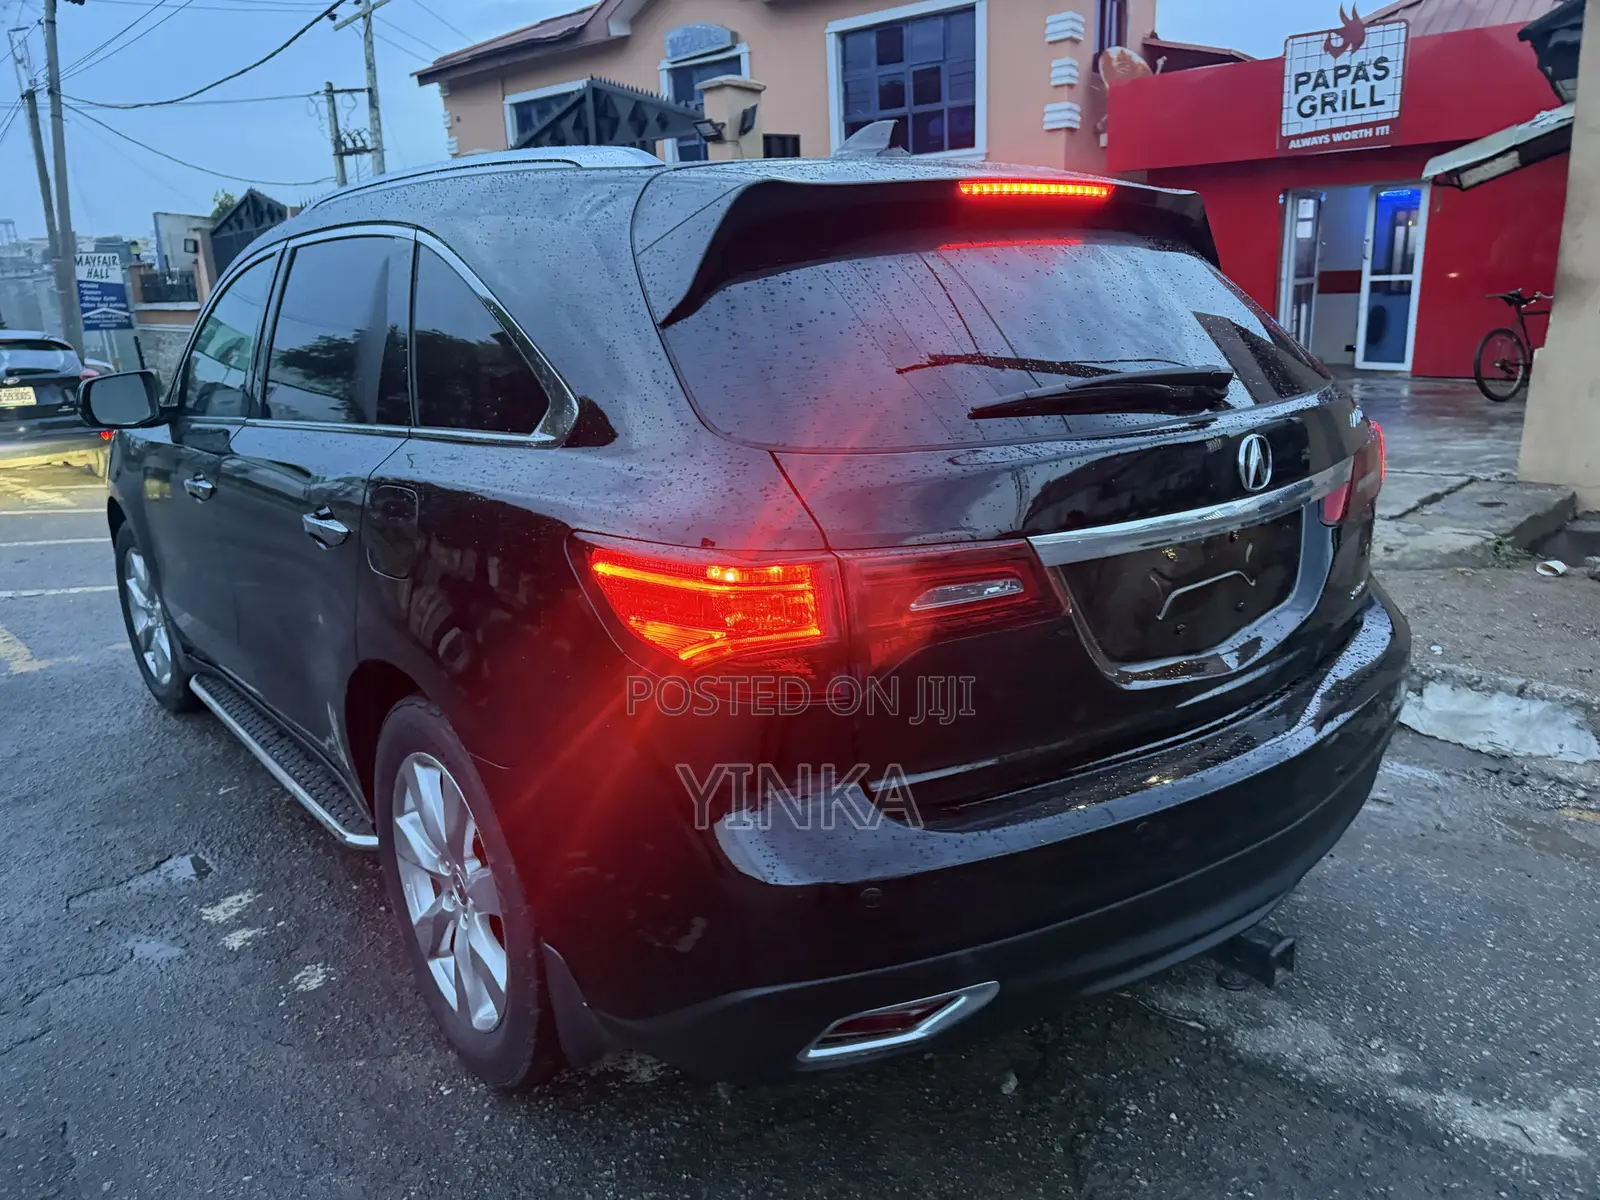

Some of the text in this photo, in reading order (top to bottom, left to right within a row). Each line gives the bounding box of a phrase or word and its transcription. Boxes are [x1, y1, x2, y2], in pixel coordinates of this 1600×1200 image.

[1297, 85, 1385, 118] GRILL
[1288, 125, 1390, 149] ALWAYS WORTH IT!
[74, 255, 118, 266] MAYFAIR
[86, 267, 110, 279] HALL
